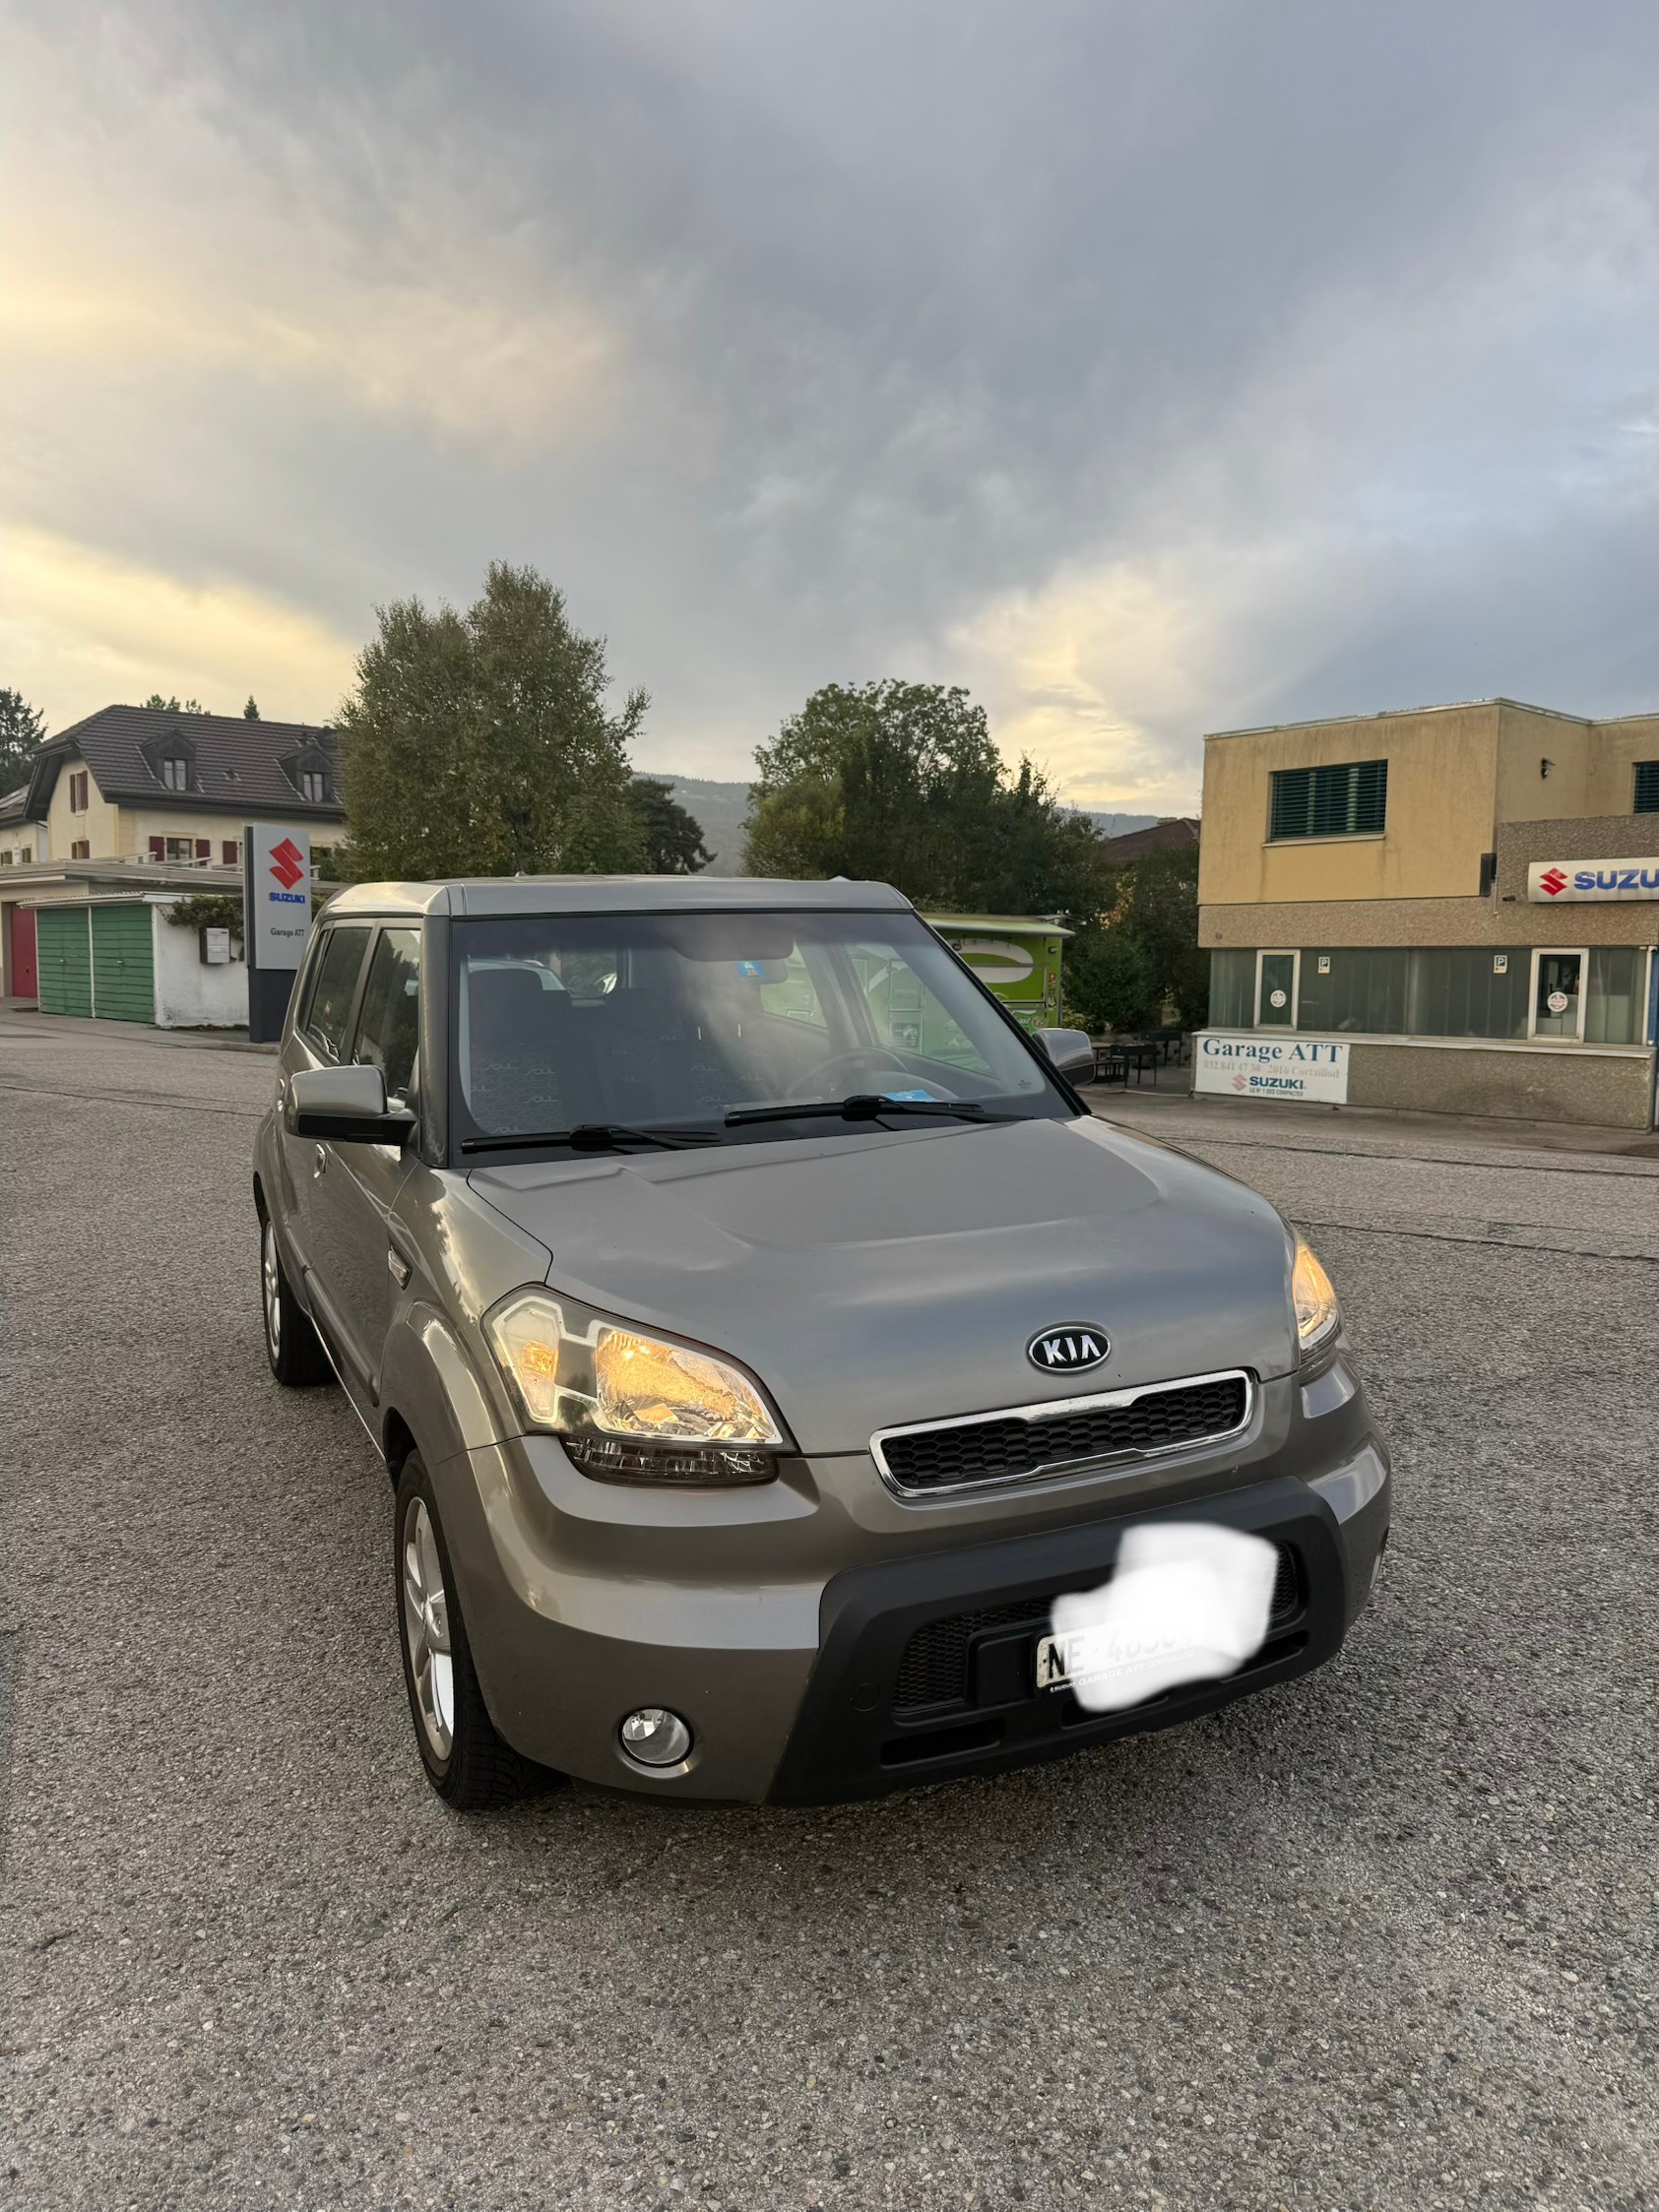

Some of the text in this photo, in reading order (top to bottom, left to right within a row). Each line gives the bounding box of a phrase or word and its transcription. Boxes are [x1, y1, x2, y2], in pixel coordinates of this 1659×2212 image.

[269, 892, 305, 905] SUZUKI
[271, 927, 293, 938] Garage
[1203, 1038, 1342, 1063] Garage ATT
[1249, 1076, 1304, 1090] SUZUKI
[1042, 1335, 1101, 1364] KIA
[1079, 1671, 1122, 1686] GARAGE
[1125, 1663, 1147, 1675] ATT
